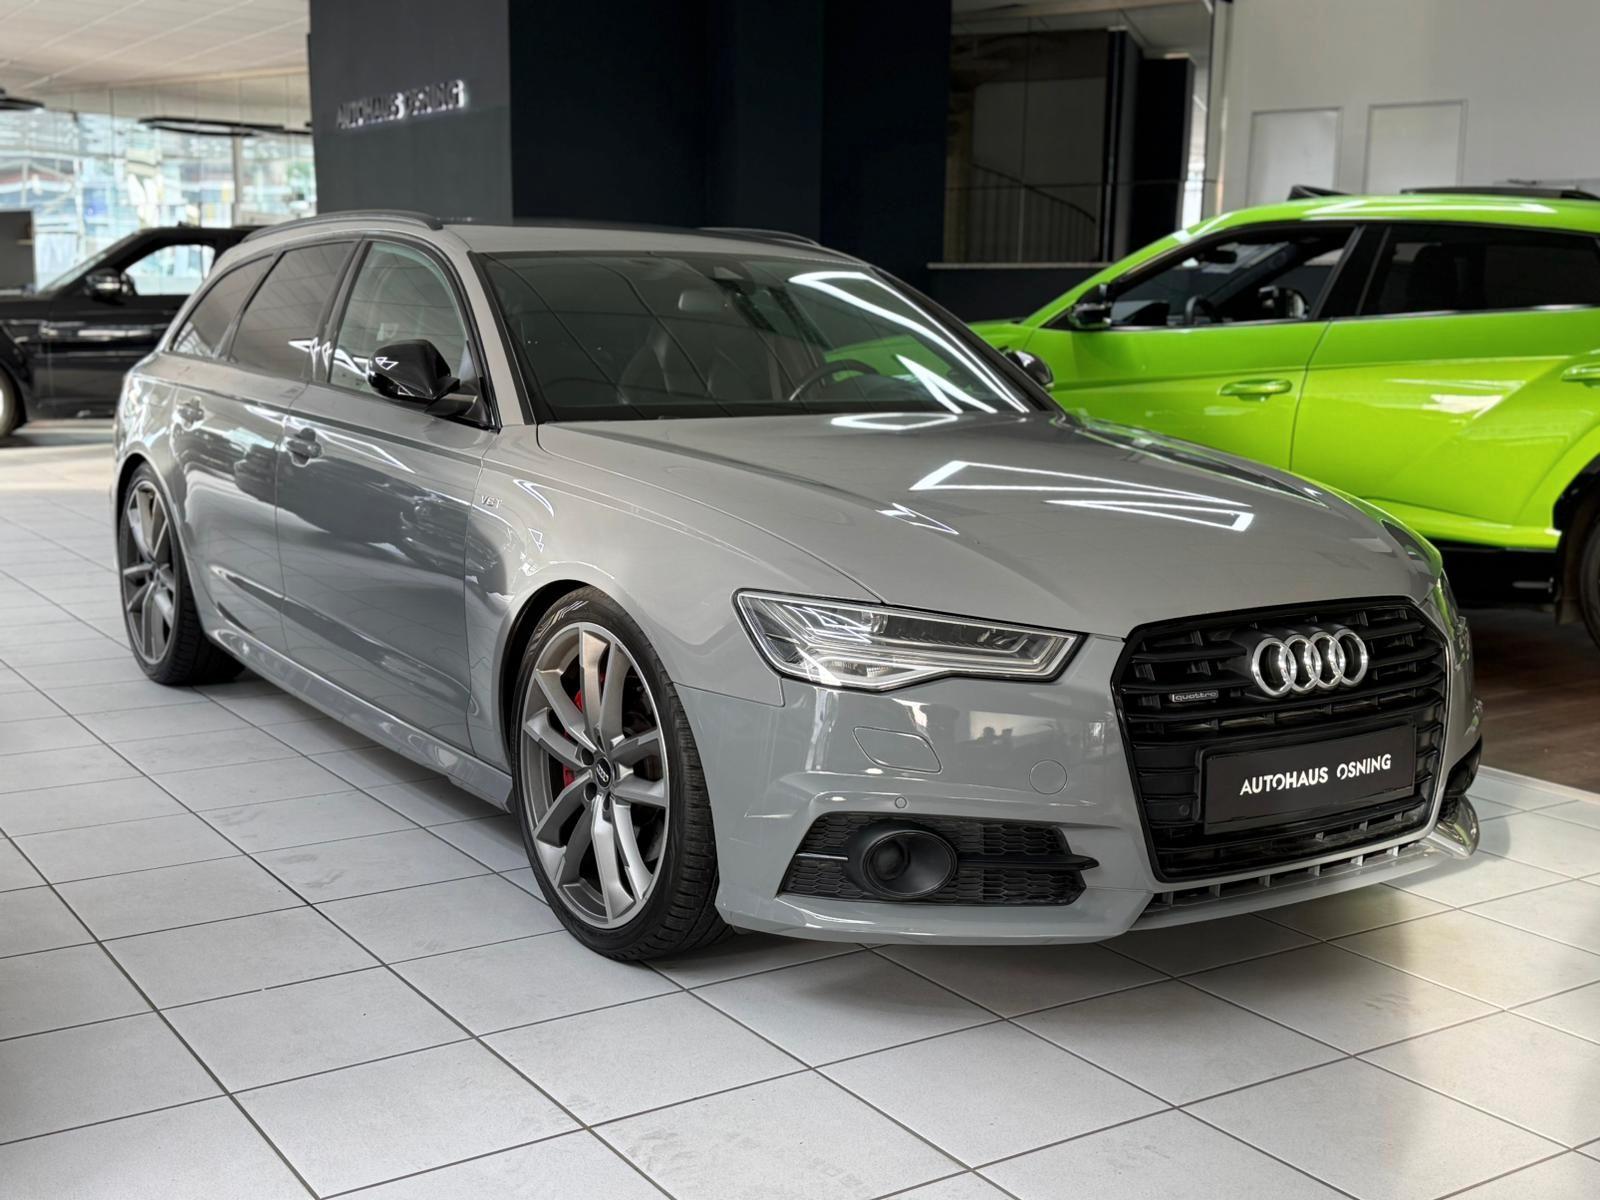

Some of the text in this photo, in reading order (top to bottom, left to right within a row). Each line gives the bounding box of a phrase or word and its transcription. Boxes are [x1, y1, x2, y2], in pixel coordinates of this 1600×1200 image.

[1174, 691, 1217, 702] quattro
[1239, 753, 1392, 796] AUTOHAUS OSNING
